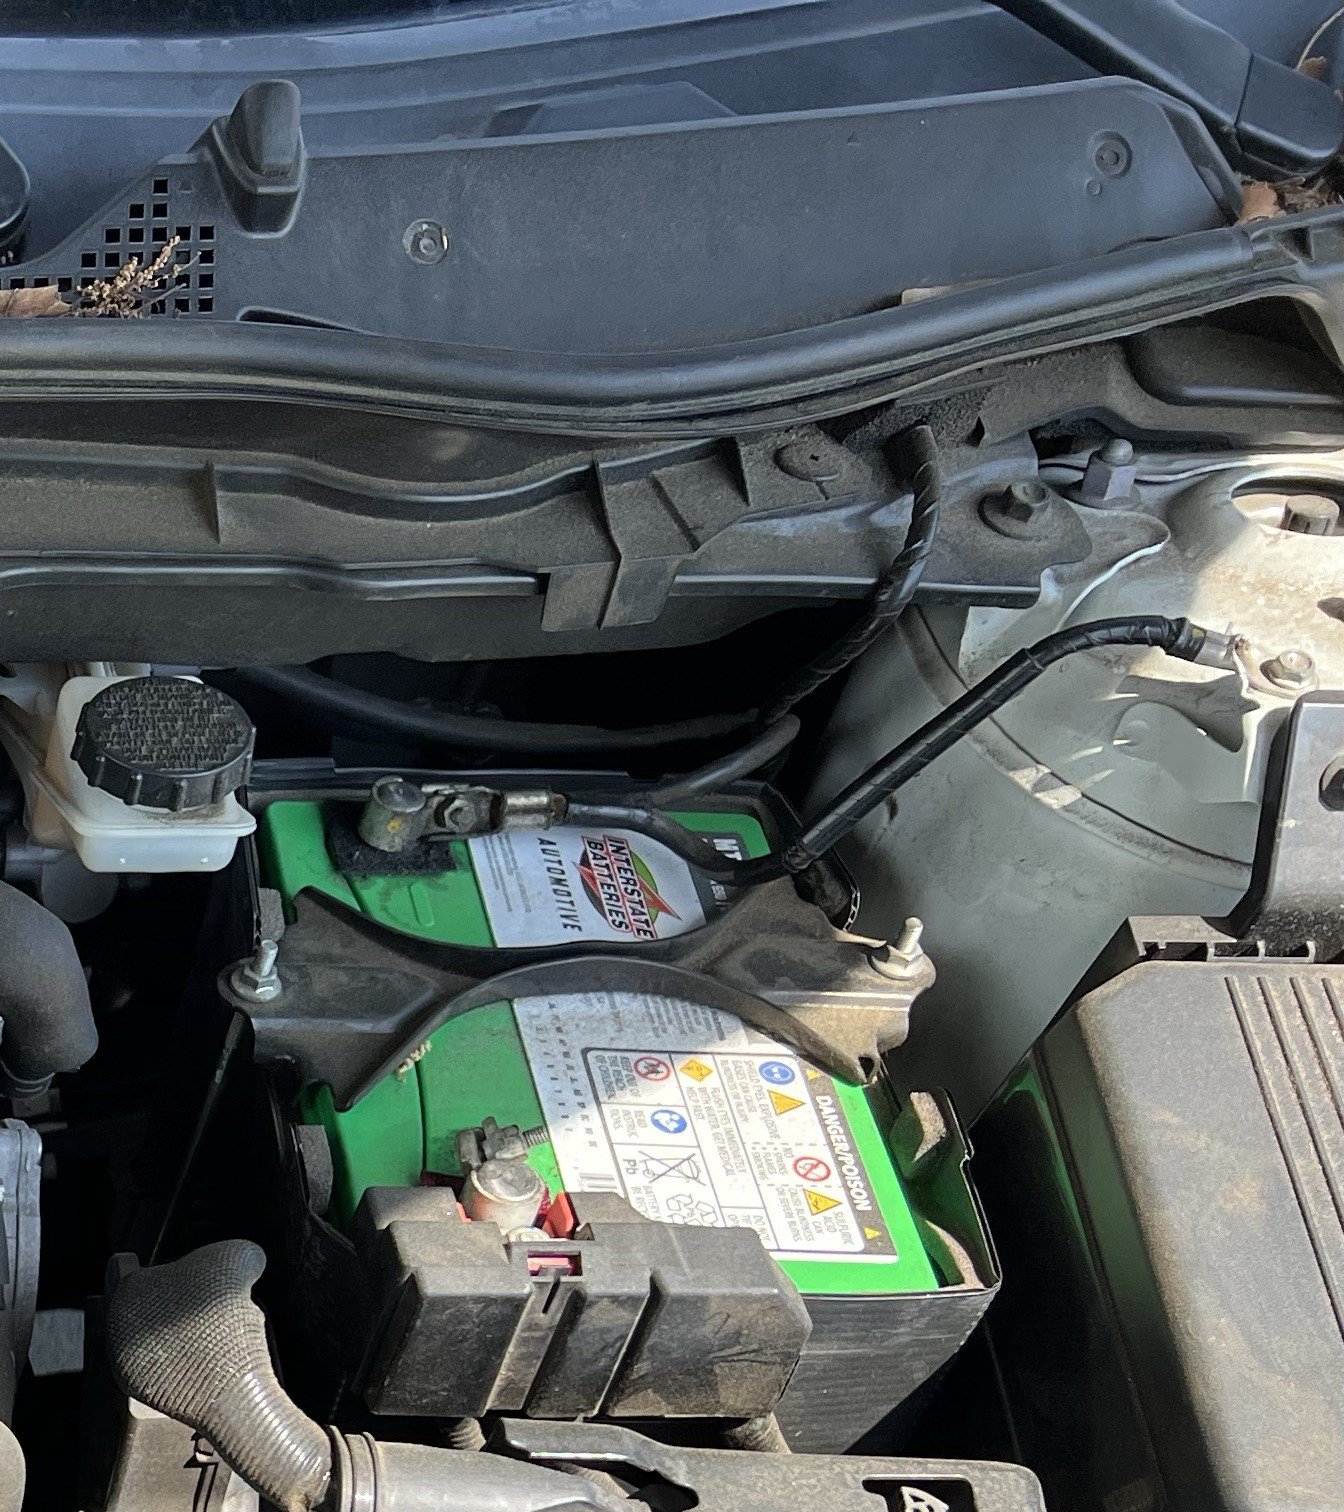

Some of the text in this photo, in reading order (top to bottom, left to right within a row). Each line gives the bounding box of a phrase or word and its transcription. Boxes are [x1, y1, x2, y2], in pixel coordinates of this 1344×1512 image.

[537, 836, 583, 932] AUTOMOTIVE
[586, 839, 629, 932] BATTERIES
[608, 837, 655, 940] INTERSTATE
[623, 1158, 638, 1176] Pb
[815, 1095, 872, 1212] DANGER/POISON
